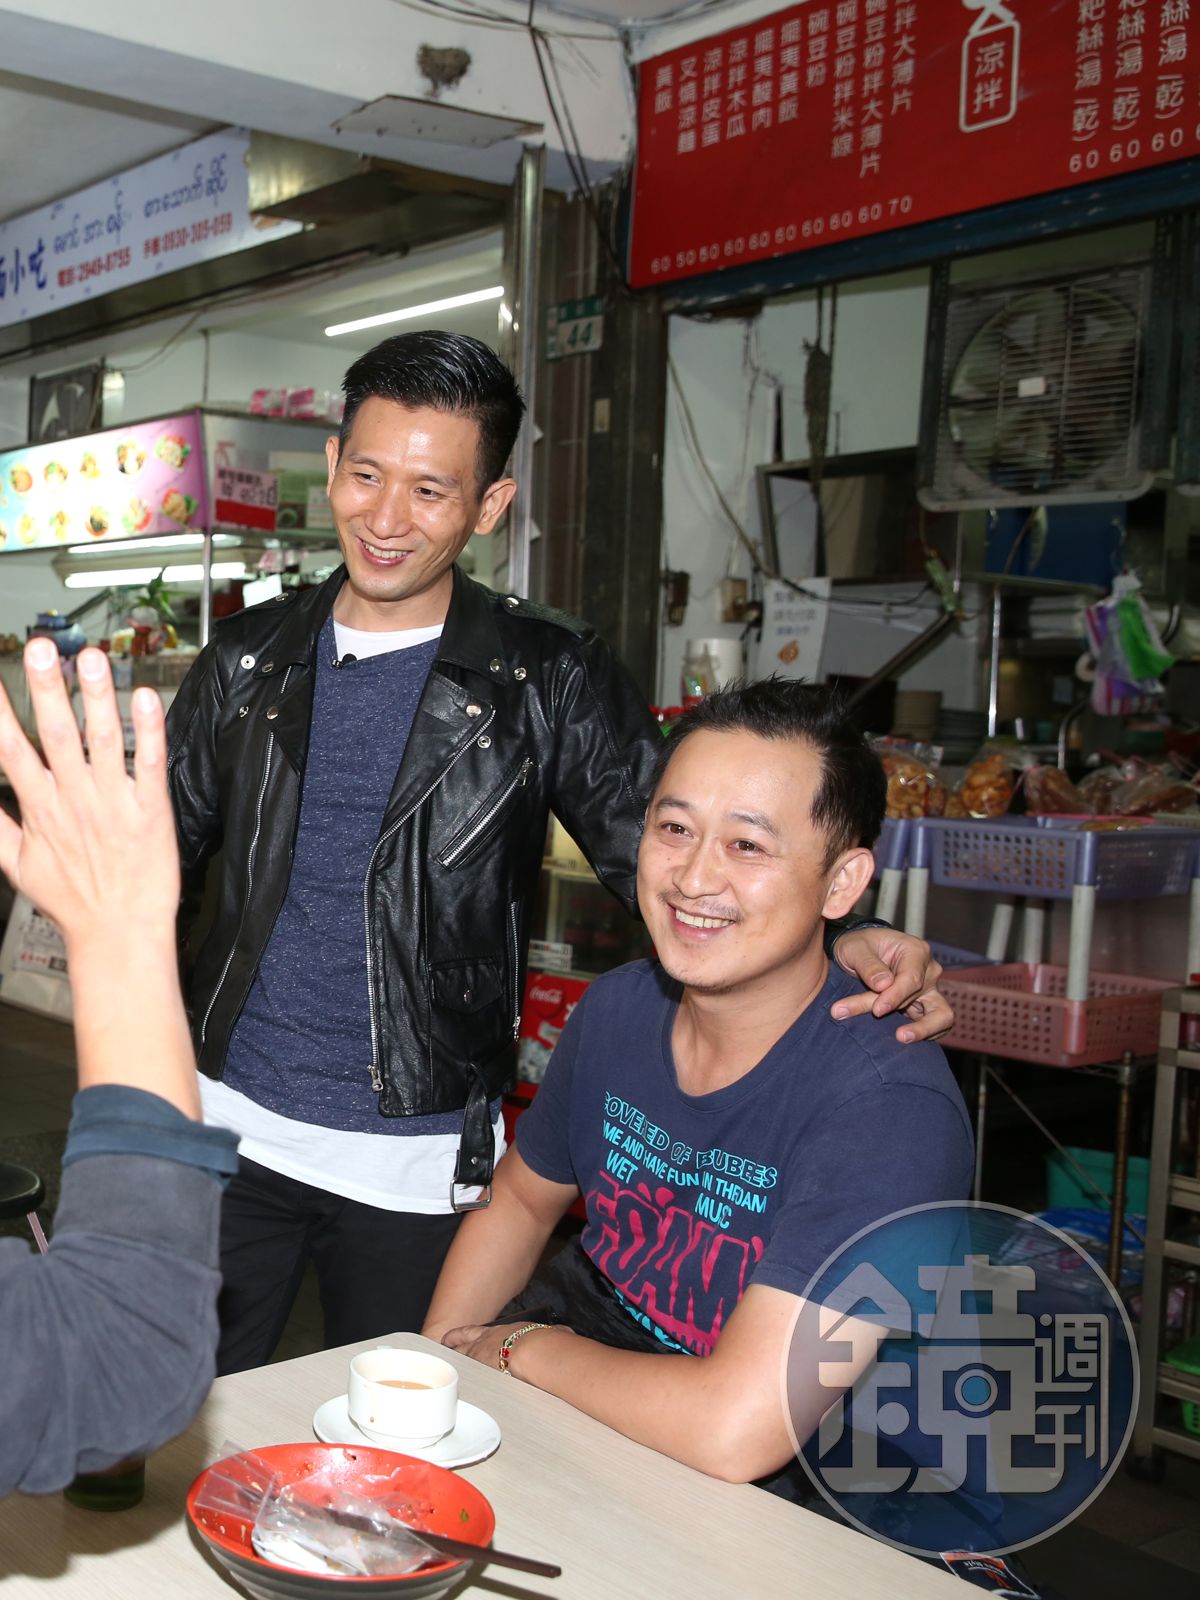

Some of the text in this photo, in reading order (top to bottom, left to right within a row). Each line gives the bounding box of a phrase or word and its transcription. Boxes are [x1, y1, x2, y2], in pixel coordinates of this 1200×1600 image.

[891, 0, 918, 116] 拌大薄片
[972, 40, 1006, 115] 涼拌
[1069, 128, 1183, 173] 60 60 60
[858, 203, 881, 224] 60
[888, 195, 912, 216] 70
[606, 1149, 639, 1185] WET
[621, 1135, 645, 1161] AND
[643, 1149, 669, 1180] HAVE
[666, 1168, 700, 1187] FUN
[702, 1171, 714, 1191] IN
[671, 1142, 693, 1165] OF
